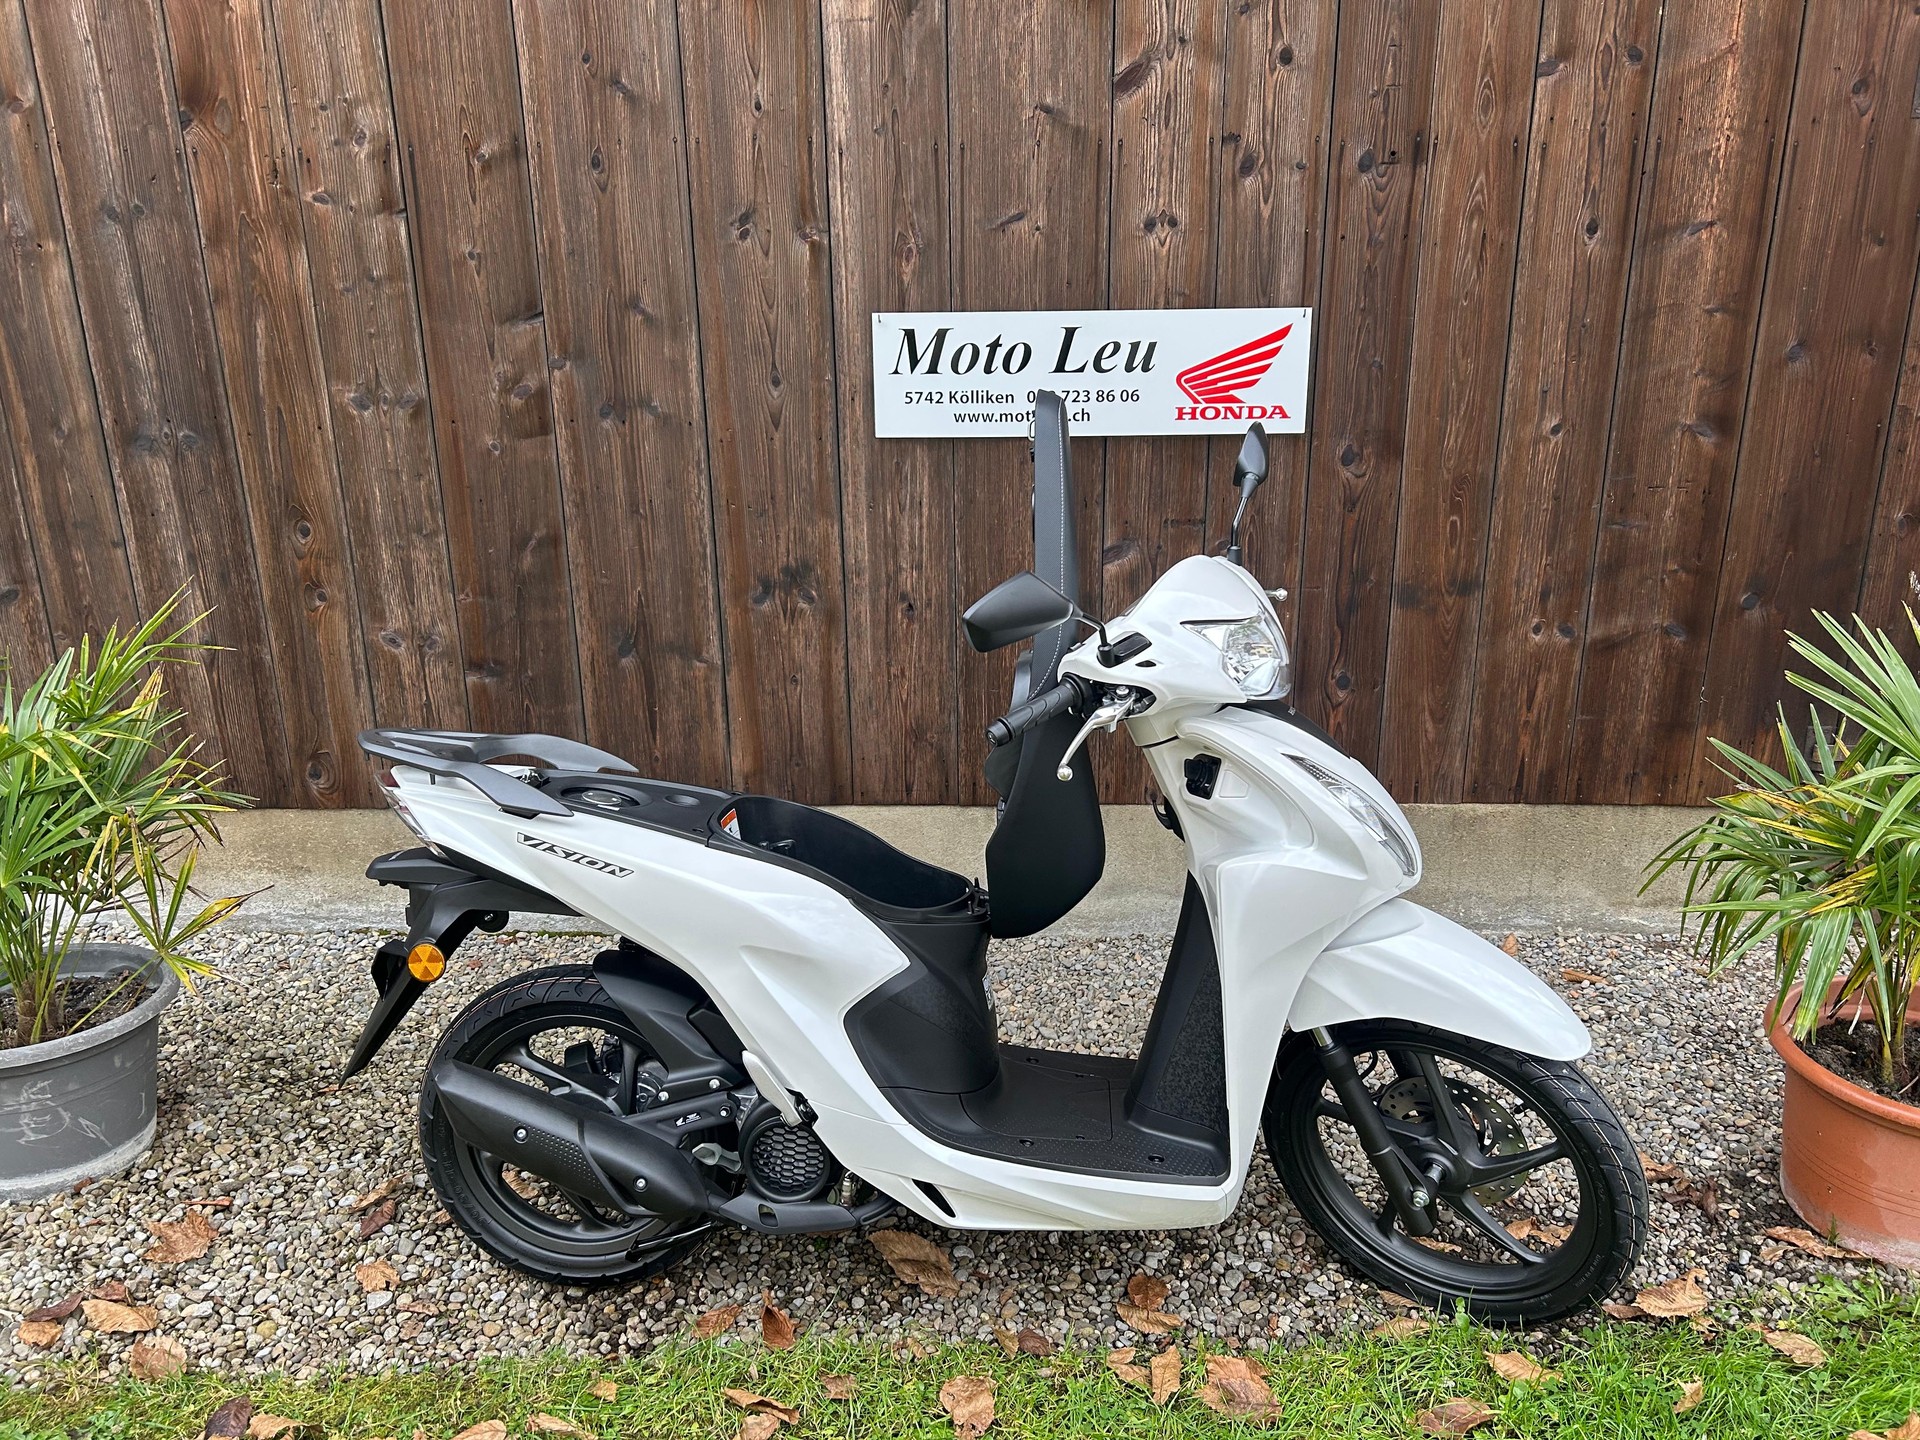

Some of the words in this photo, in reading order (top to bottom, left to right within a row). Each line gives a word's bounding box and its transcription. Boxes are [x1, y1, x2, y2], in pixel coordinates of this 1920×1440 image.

[888, 327, 1032, 375] Moto
[1048, 326, 1158, 374] Leu
[904, 391, 944, 404] 5742
[949, 390, 1015, 404] Kölliken
[1061, 390, 1091, 403] 723
[1095, 389, 1116, 403] 86
[1120, 389, 1140, 403] 06
[953, 408, 1091, 423] www.mot.ch
[1175, 405, 1291, 420] HONDA
[517, 832, 634, 878] VISION
